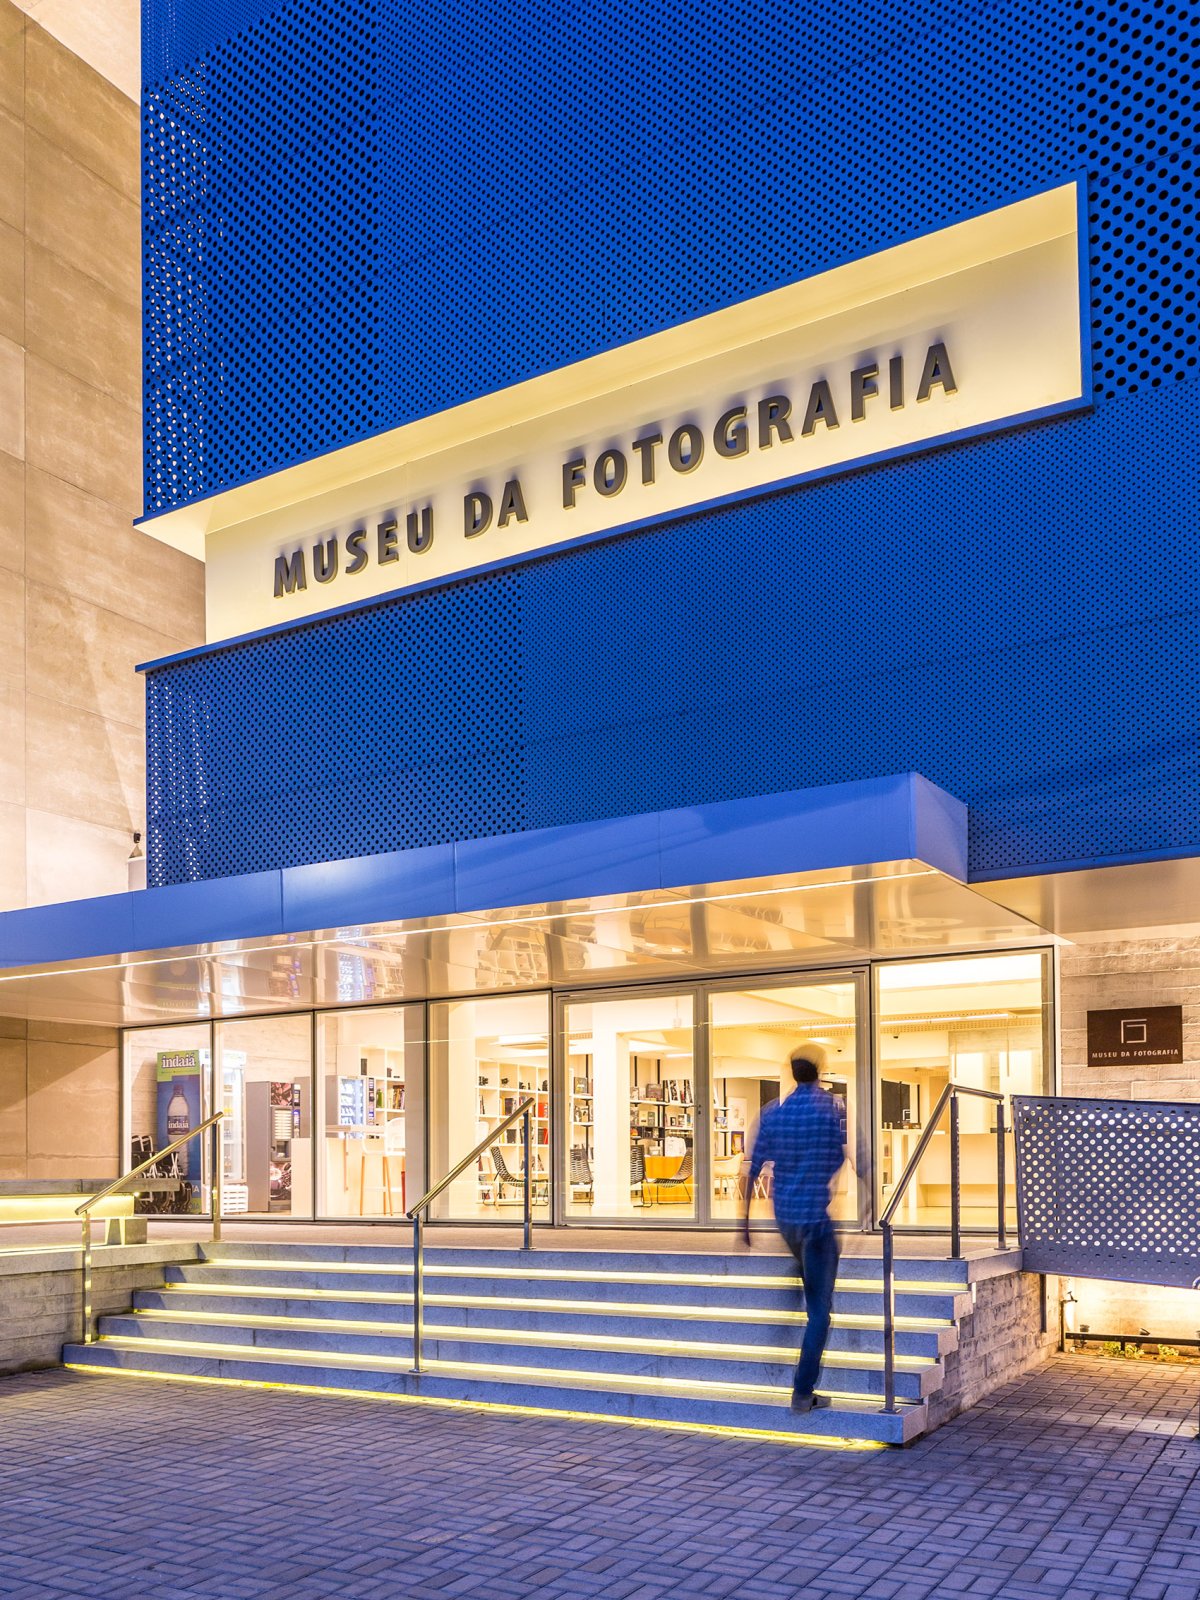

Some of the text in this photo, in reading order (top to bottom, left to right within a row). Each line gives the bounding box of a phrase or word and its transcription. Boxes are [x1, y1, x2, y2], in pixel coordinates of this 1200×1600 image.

[273, 342, 959, 599] MUSEU DA FOTOGRAFIA
[161, 1053, 196, 1068] indaiá
